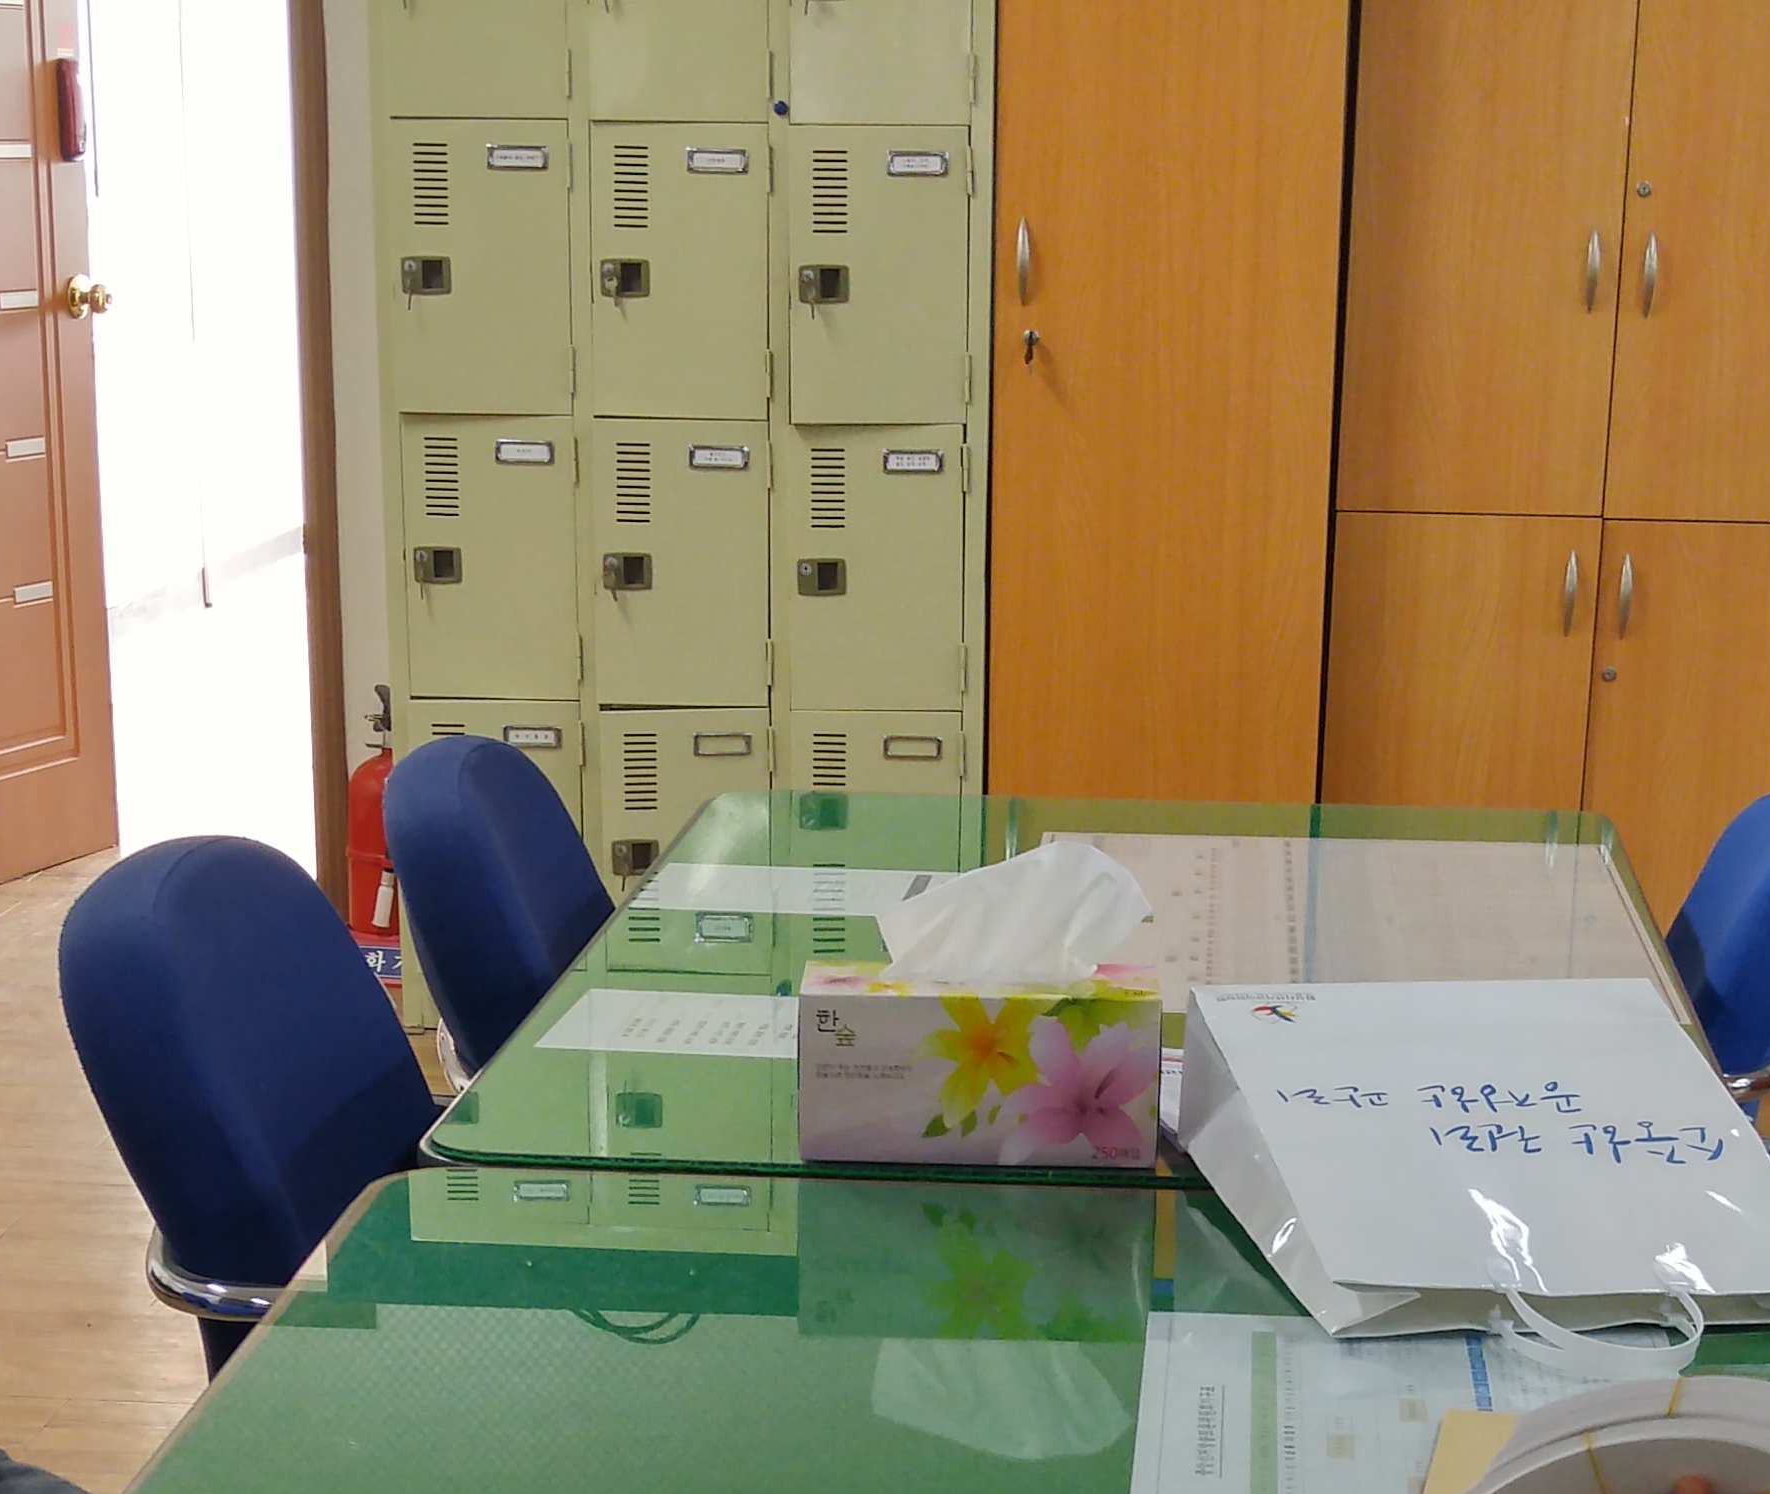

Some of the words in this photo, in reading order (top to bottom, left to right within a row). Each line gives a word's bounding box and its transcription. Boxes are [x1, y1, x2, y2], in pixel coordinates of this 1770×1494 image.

[1275, 1085, 1390, 1109] 관리
[1416, 1081, 1583, 1114] 공정한
[1429, 1124, 1542, 1154] 권리
[1568, 1121, 1724, 1164] 소중한
